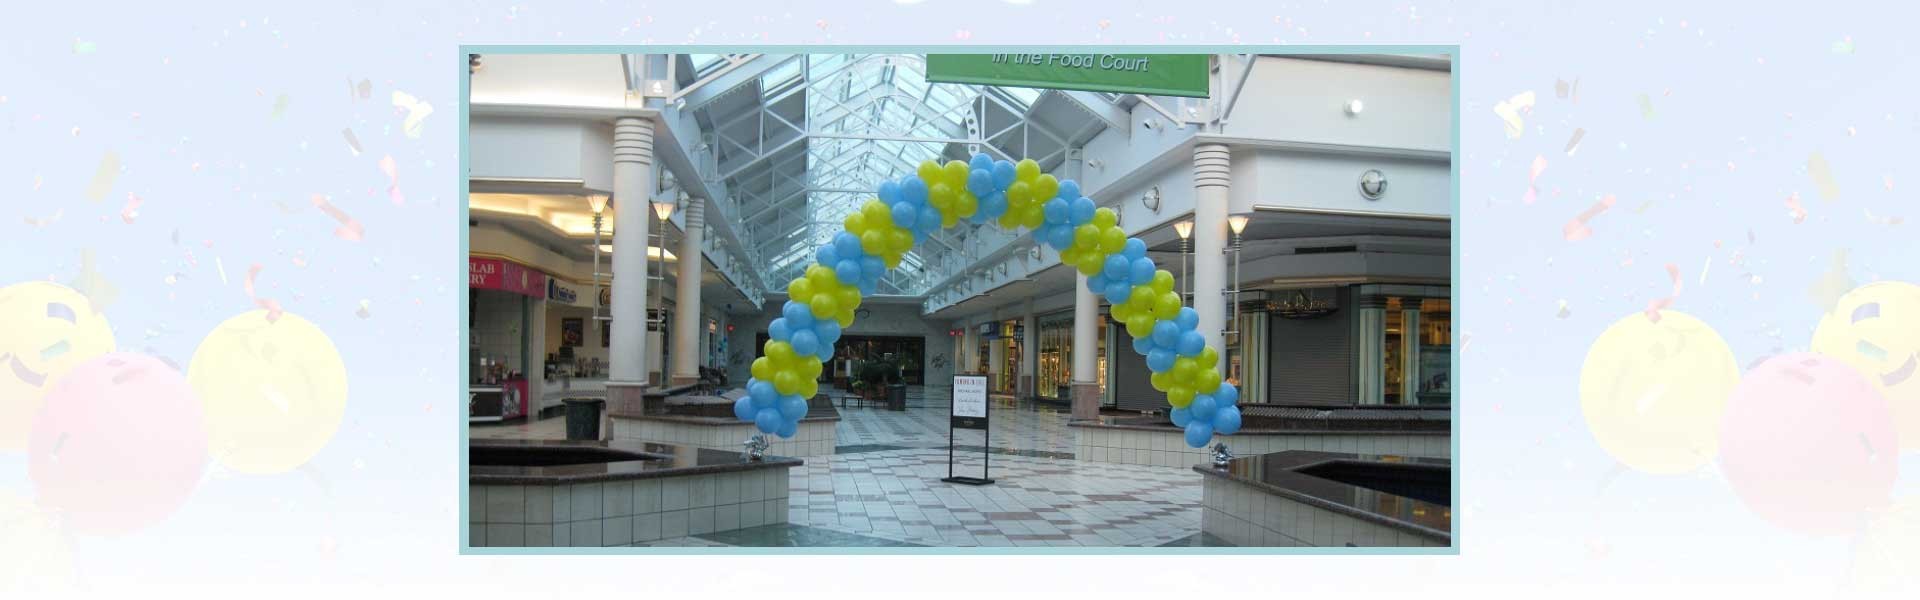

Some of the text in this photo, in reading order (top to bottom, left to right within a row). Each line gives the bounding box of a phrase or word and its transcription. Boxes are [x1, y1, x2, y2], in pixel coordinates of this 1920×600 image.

[1014, 53, 1043, 65] the
[1048, 53, 1095, 68] Food
[1100, 54, 1149, 72] Court
